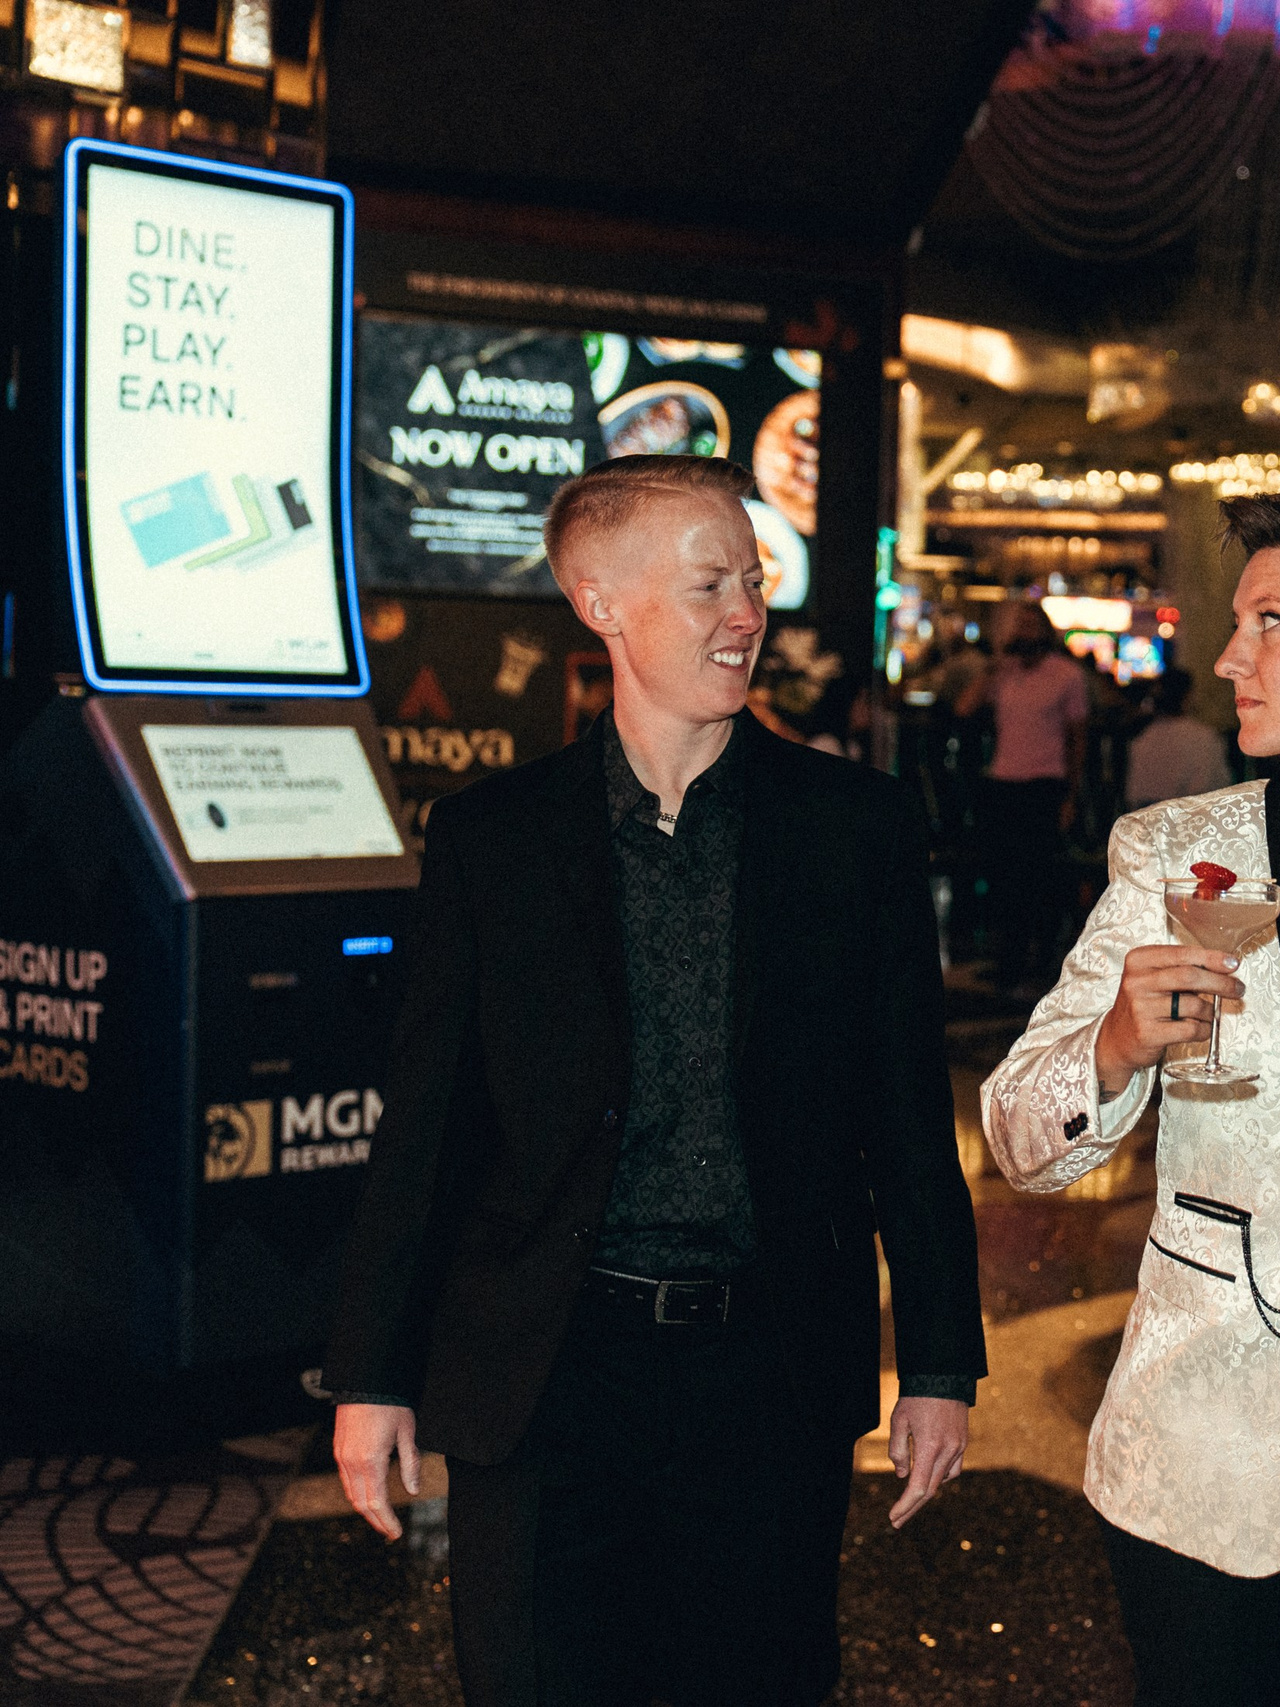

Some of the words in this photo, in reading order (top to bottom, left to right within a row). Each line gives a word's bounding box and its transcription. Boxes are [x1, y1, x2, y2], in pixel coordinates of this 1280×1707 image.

[134, 219, 248, 272] DINE.
[127, 270, 236, 320] STAY.
[122, 322, 234, 370] PLAY.
[118, 374, 247, 422] EARN.
[389, 425, 483, 469] NOW
[484, 432, 586, 476] OPEN
[381, 724, 515, 772] maya
[65, 948, 108, 992] UP
[15, 990, 104, 1044] PRINT
[0, 1038, 90, 1092] CARDS
[280, 1138, 372, 1174] REWAR
